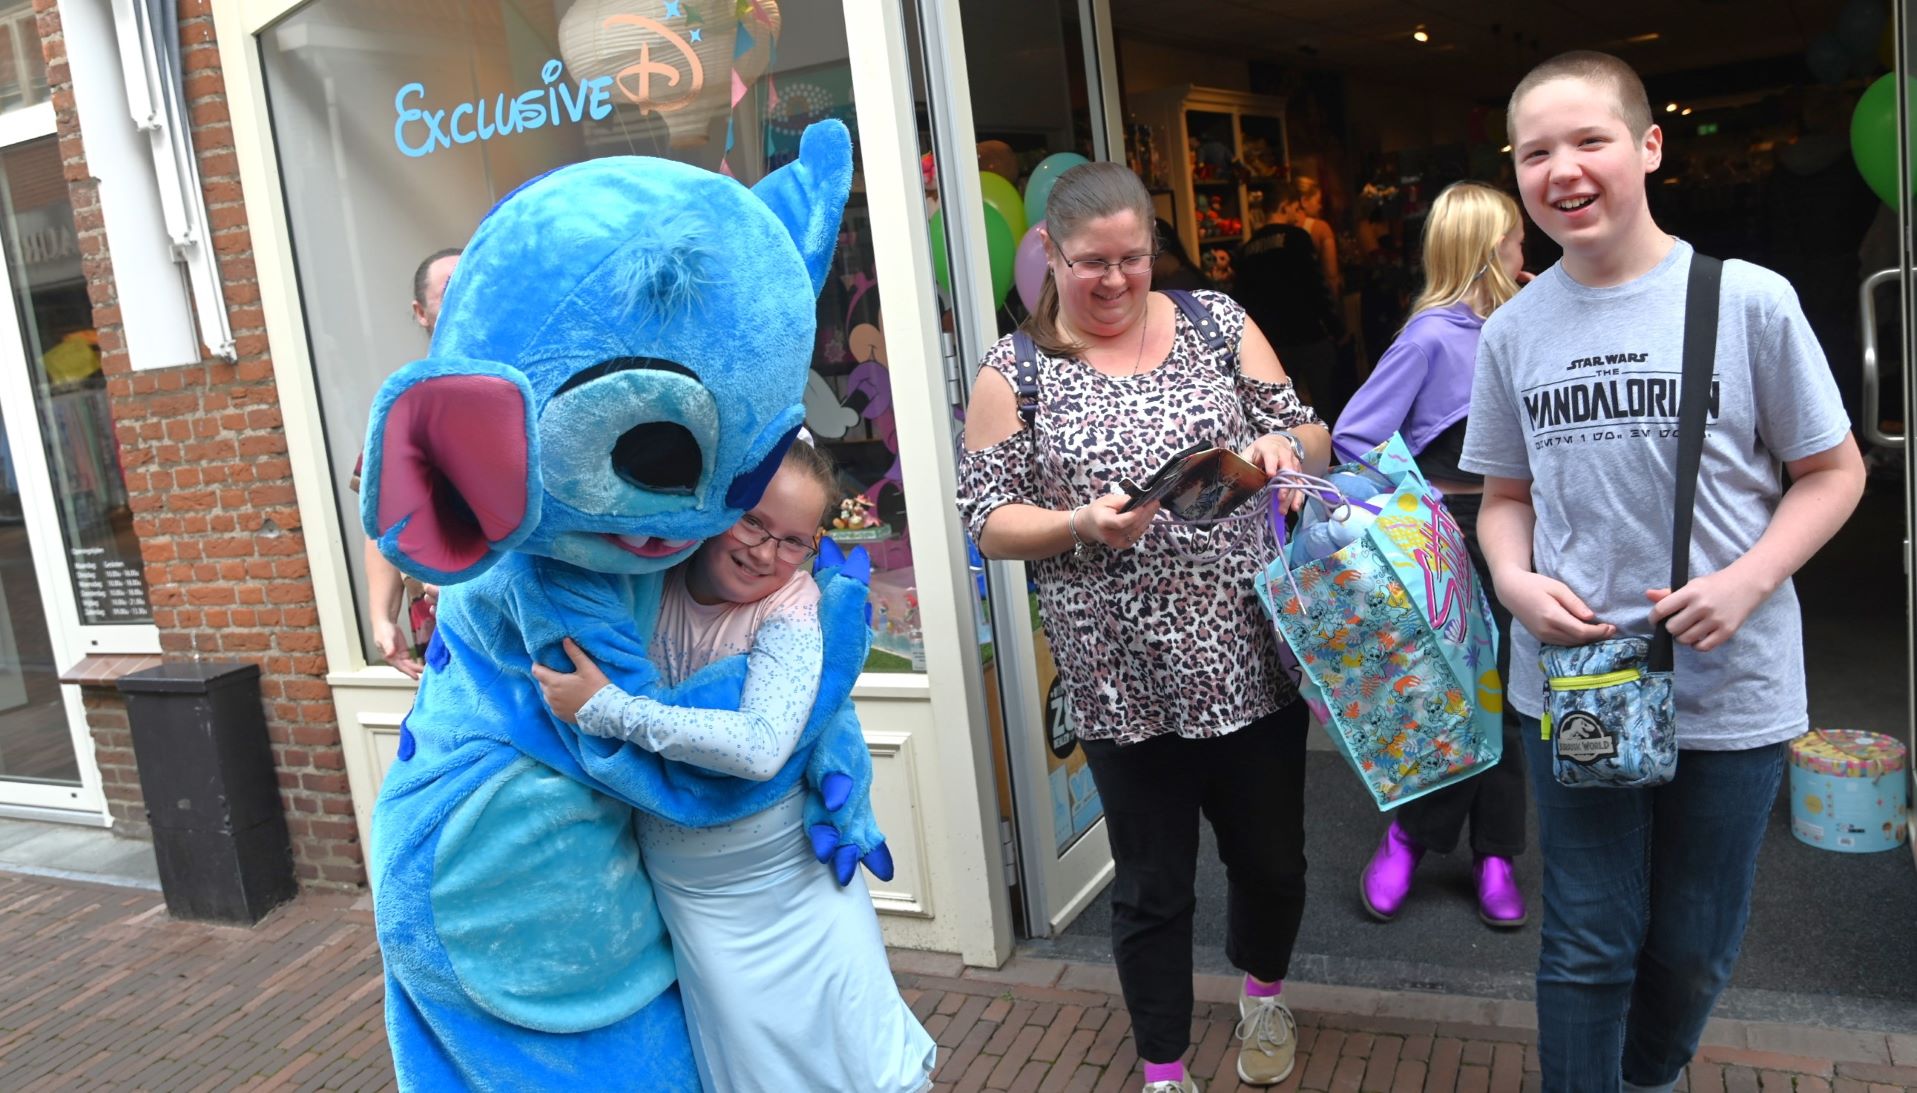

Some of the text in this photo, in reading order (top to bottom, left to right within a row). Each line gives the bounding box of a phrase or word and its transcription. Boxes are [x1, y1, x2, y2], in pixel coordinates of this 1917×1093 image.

[1566, 353, 1649, 371] STAR WARS
[1596, 368, 1620, 377] THE
[1523, 378, 1720, 431] MANDALORIN
[1581, 740, 1610, 751] WORLD
